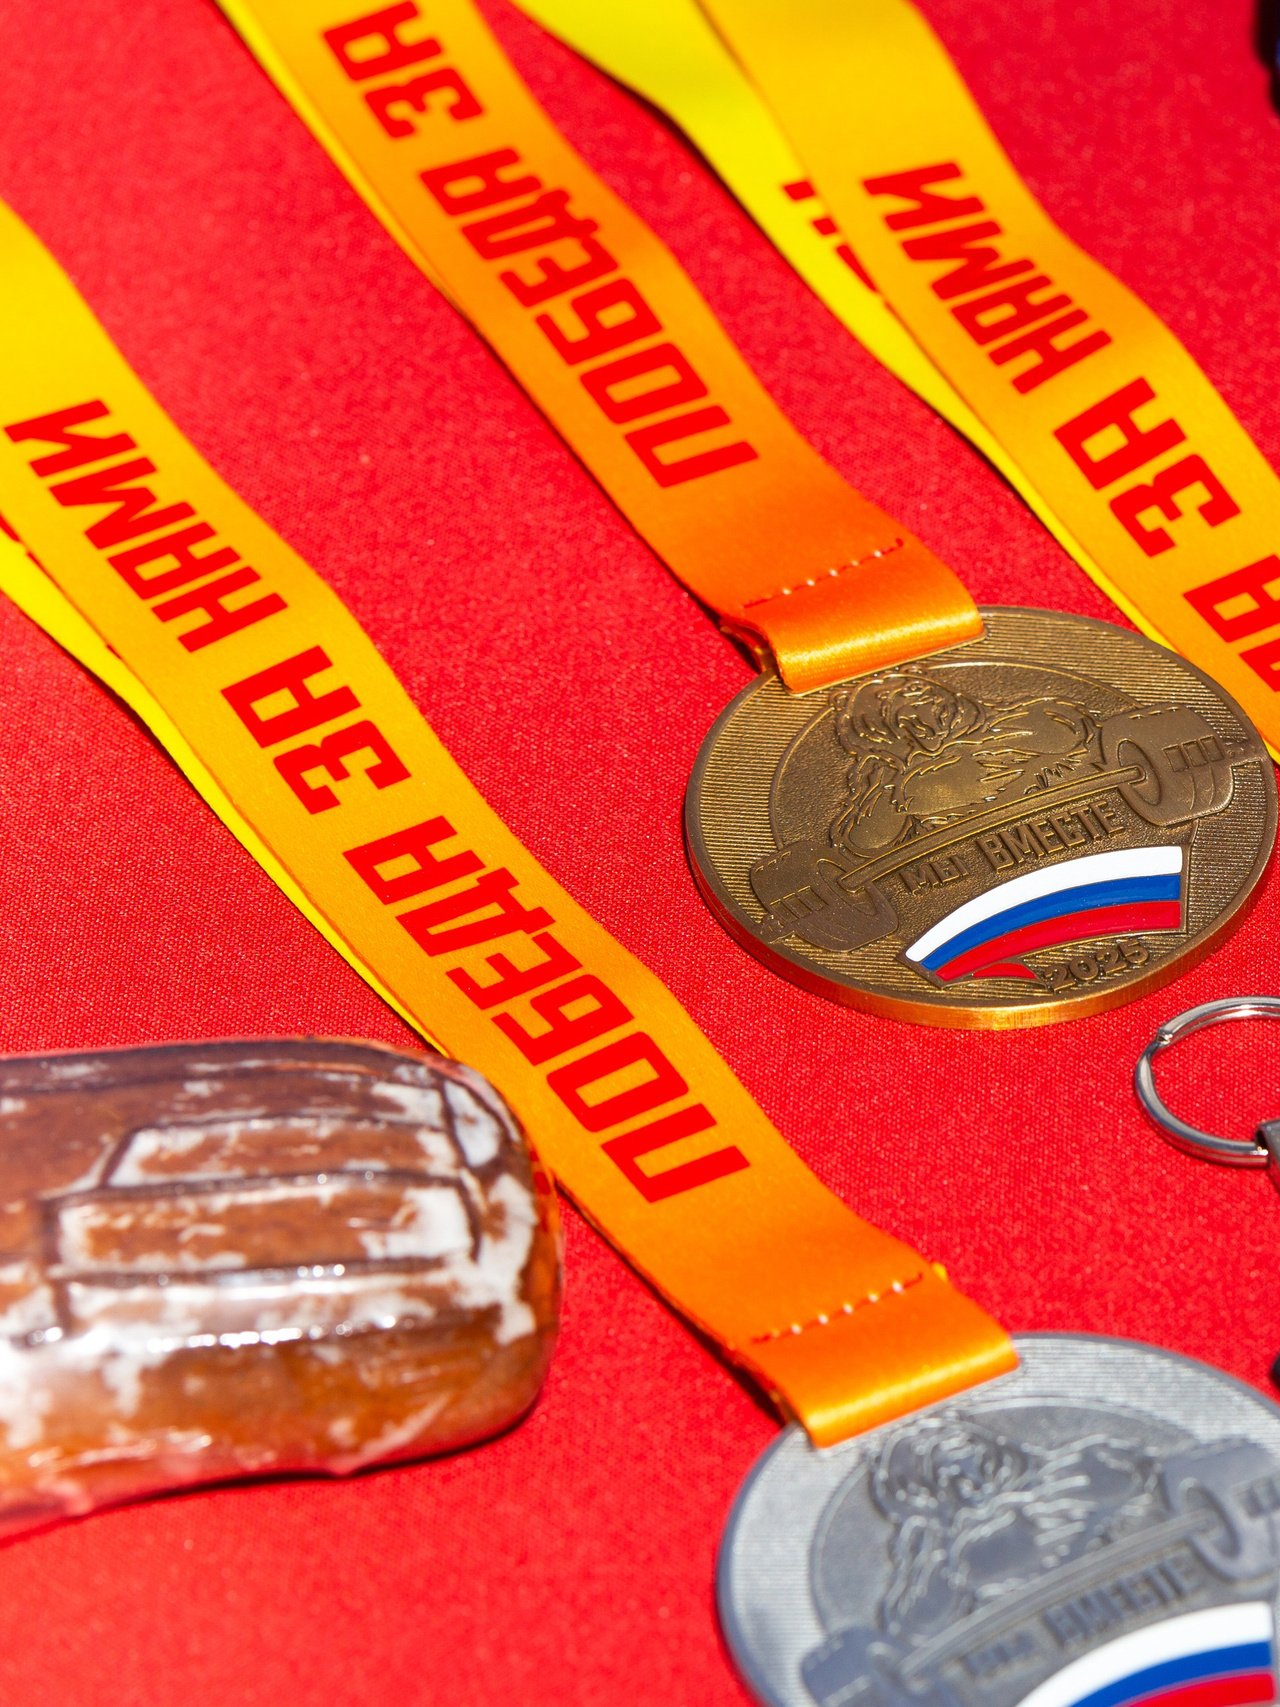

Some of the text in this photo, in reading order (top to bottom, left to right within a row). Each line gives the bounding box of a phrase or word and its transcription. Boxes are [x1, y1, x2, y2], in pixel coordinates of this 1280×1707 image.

[323, 3, 760, 489] ПОБЕДА ЗА
[863, 162, 1113, 395] НАМИ
[1053, 377, 1241, 558] ЗА
[4, 399, 751, 1204] ПОБЕДА ЗА НАМИ
[977, 800, 1125, 875] ВМЕСТЕ
[1043, 943, 1149, 993] 2025
